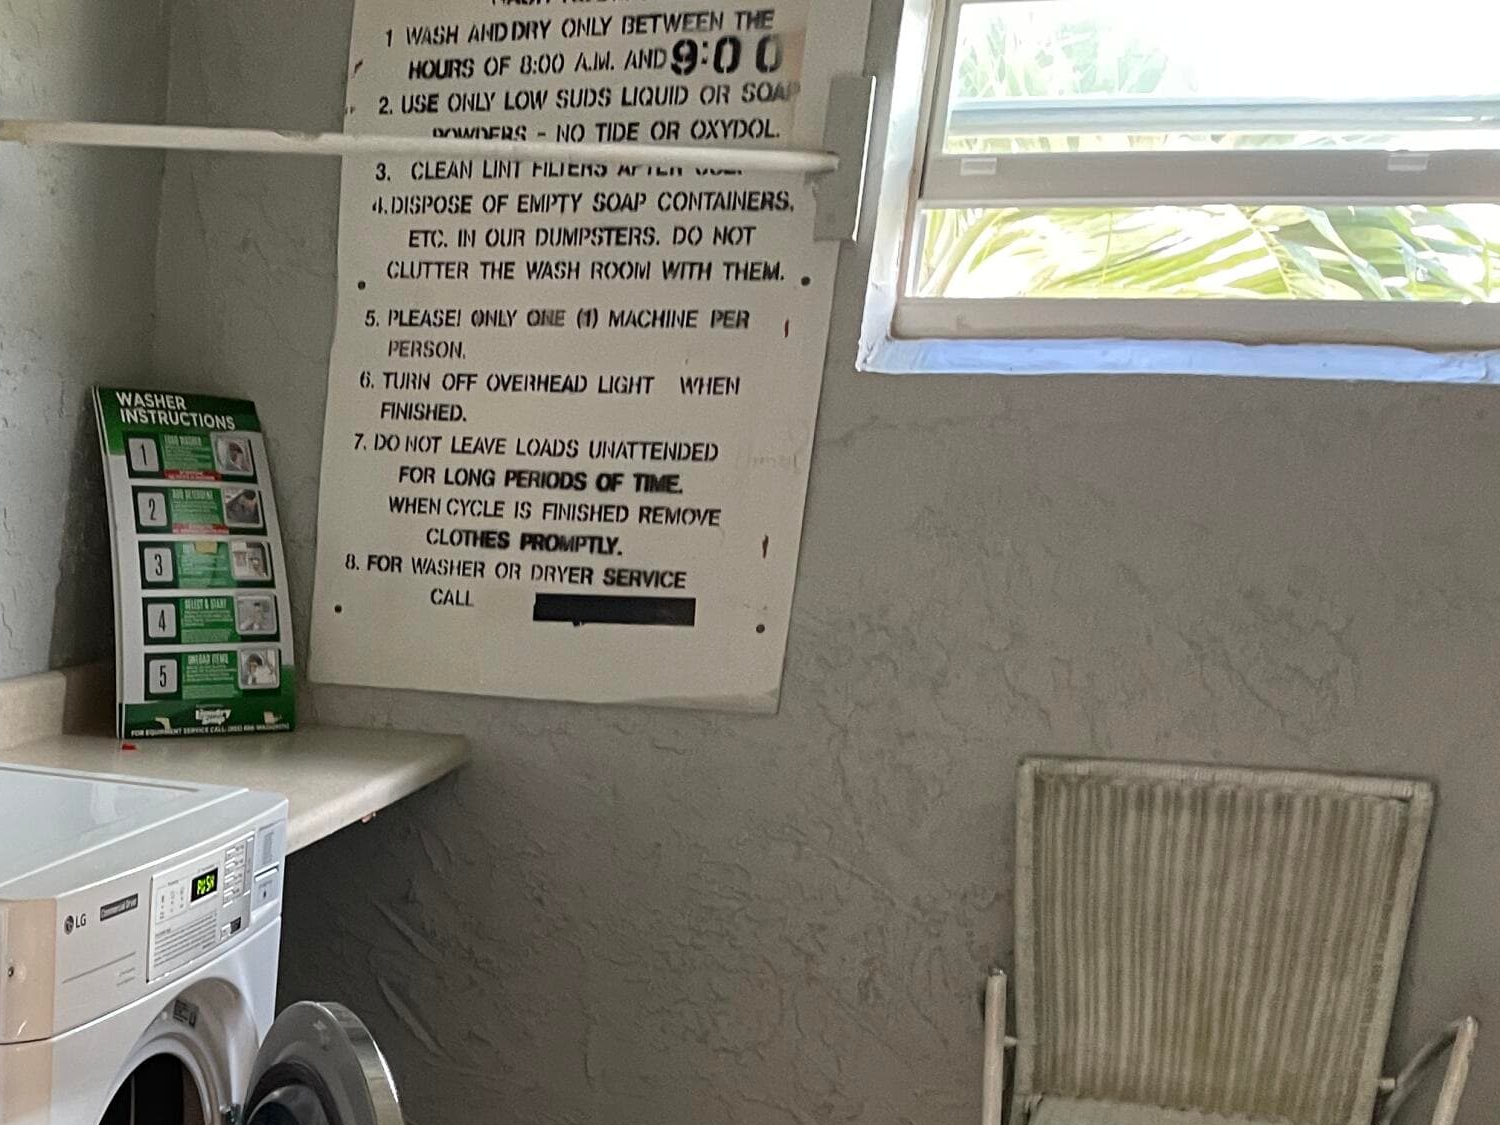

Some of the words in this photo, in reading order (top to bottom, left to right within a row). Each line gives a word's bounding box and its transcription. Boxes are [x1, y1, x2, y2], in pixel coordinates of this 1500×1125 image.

[407, 25, 459, 46] WASH
[468, 22, 507, 43] AND
[511, 19, 551, 41] DRY
[561, 17, 612, 38] ONLY
[621, 11, 724, 35] BETWEEN
[734, 9, 775, 31] THE
[408, 57, 475, 80] HOURS
[484, 55, 511, 77] OF
[520, 53, 565, 75] 8:00
[574, 50, 615, 72] A.M.
[624, 48, 668, 71] AND
[379, 96, 393, 115] 2.
[401, 93, 439, 114] USE
[448, 91, 496, 113] ONLY
[504, 90, 548, 111] LOW
[556, 87, 612, 109] SUDS
[621, 85, 689, 107] LIQUID
[700, 84, 731, 105] OR
[556, 123, 586, 143] NO
[596, 121, 640, 142] TIDE
[650, 121, 680, 141] OR
[690, 118, 780, 141] OXYDOL.
[375, 162, 391, 181] 3.
[411, 159, 473, 181] CLEAN
[482, 159, 521, 179] LINT
[391, 194, 473, 214] DISPOSE
[482, 194, 509, 214] OF
[517, 193, 582, 214] EMPTY
[592, 192, 646, 213] SOAP
[408, 229, 448, 248] ETC.
[458, 229, 476, 248] IN
[485, 228, 525, 247] OUR
[535, 226, 660, 247] DUMPSTERS.
[673, 226, 703, 246] DO
[712, 226, 757, 246] NOT
[387, 261, 469, 280] CLUTTER
[480, 261, 515, 280] THE
[526, 261, 580, 280] WASH
[590, 261, 651, 280] ROOM
[662, 260, 712, 281] WITH
[723, 261, 785, 281] THEM.
[365, 309, 379, 327] 5.
[471, 309, 517, 327] ONLY
[526, 309, 566, 327] ONE
[577, 308, 598, 329] (1)
[608, 309, 699, 329] MACHINE
[710, 309, 750, 329] PER
[359, 371, 374, 389] 6.
[383, 371, 431, 390] TURN
[442, 373, 478, 392] OFF
[486, 373, 587, 393] OVERHEAD
[598, 375, 655, 394] LIGHT
[680, 376, 740, 395] WHEN
[116, 391, 187, 410] WASHER
[120, 408, 236, 430] INSTRUCTIONS
[380, 402, 467, 422] FINISHED.
[141, 444, 147, 466] 1
[354, 433, 366, 450] 7.
[374, 433, 400, 452] DO
[405, 436, 442, 454] NOT
[451, 436, 507, 455] LEAVE
[516, 438, 579, 458] LOADS
[588, 440, 719, 462] UNATTENDED
[399, 466, 435, 484] FOR
[444, 467, 495, 487] LONG
[504, 469, 588, 491] PERIODS
[595, 473, 624, 493] OF
[633, 473, 683, 494] TIME.
[149, 498, 156, 520] 2
[389, 496, 441, 514] WHEN
[446, 498, 505, 518] CYCLE
[514, 501, 532, 519] IS
[542, 503, 629, 523] FINISHED
[638, 505, 722, 527] REMOVE
[426, 528, 510, 549] CLOTHES
[520, 532, 623, 556] PROMPTLY.
[155, 554, 163, 576] 3
[345, 553, 360, 571] 8.
[367, 554, 402, 573] FOR
[412, 557, 486, 578] WASHER
[495, 562, 521, 580] OR
[531, 564, 594, 585] DRYER
[603, 567, 687, 589] SERVICE
[430, 588, 474, 607] CALL
[158, 609, 166, 632] 4
[160, 665, 167, 687] 5
[76, 913, 86, 928] LG
